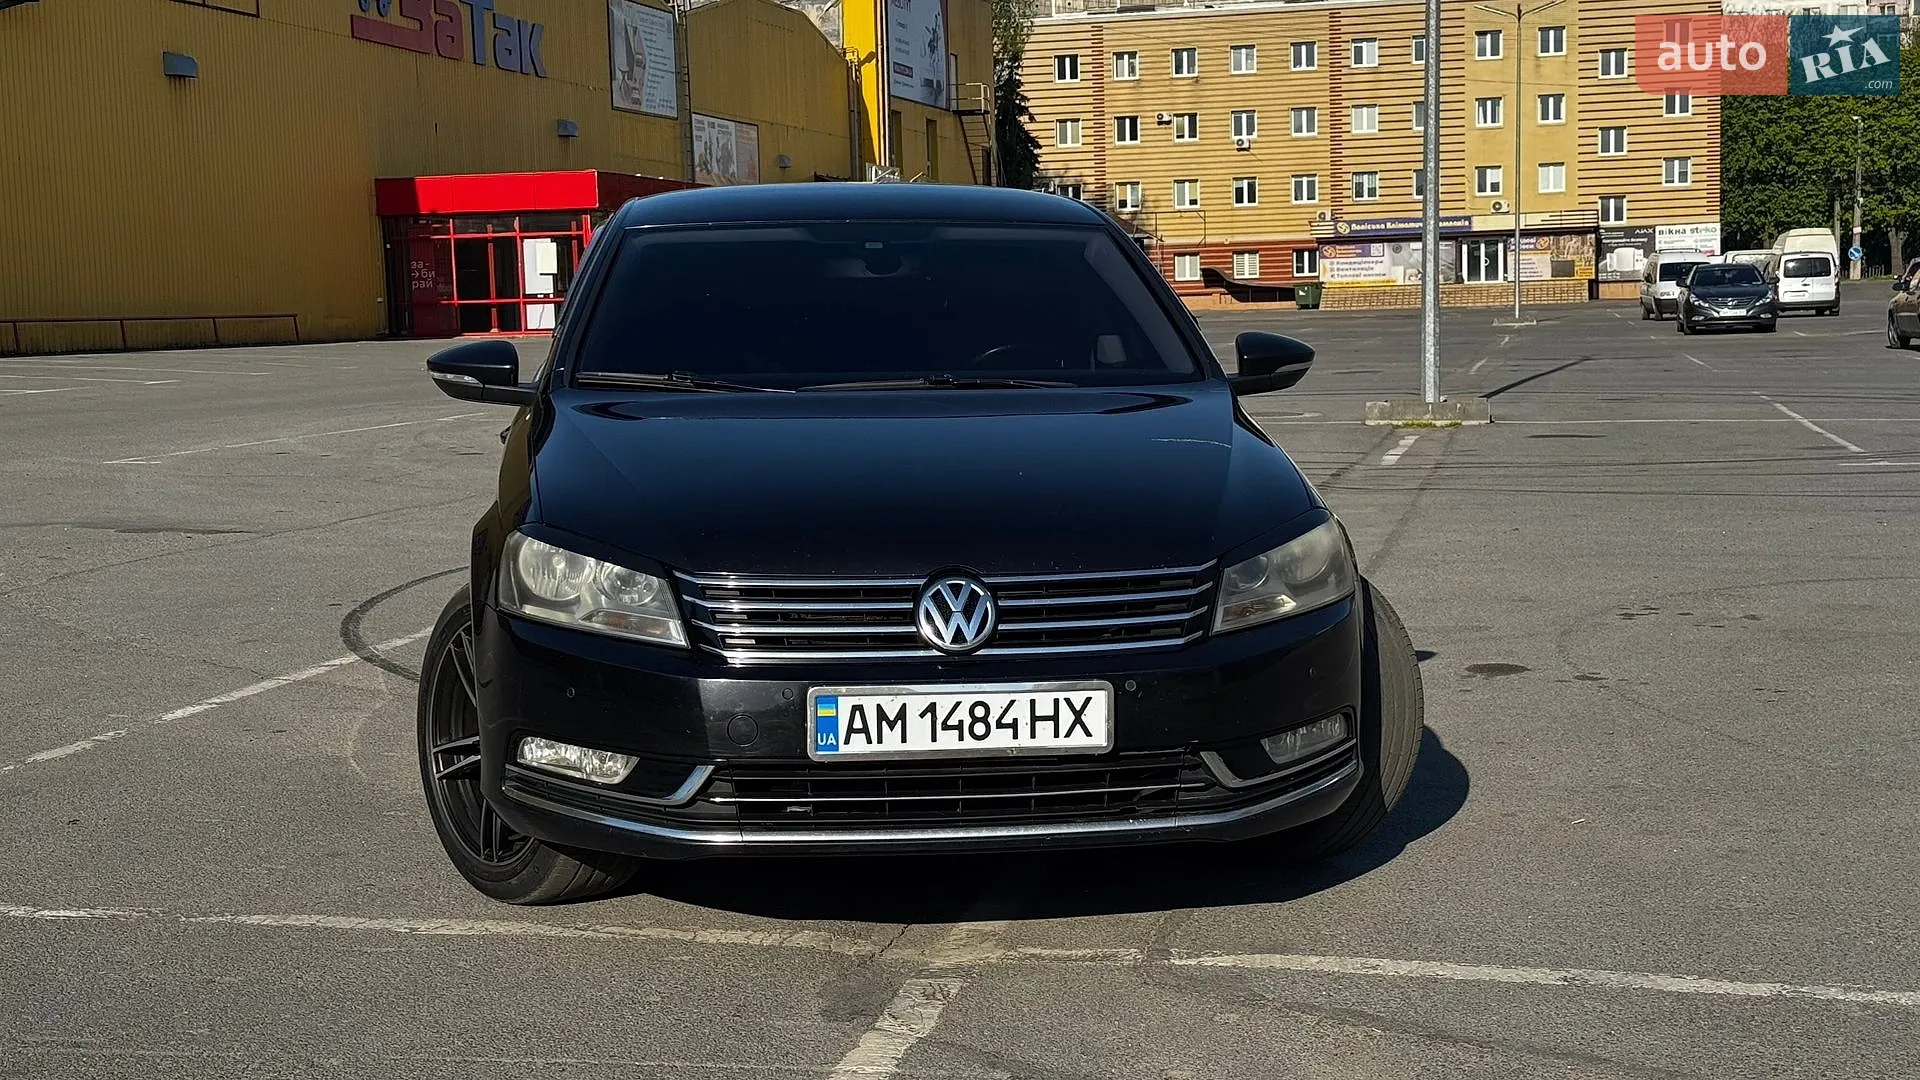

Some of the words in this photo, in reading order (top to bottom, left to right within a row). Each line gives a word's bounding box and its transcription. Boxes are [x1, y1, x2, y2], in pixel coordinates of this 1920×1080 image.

[412, 278, 433, 291] рай
[920, 579, 995, 650] VW
[843, 702, 908, 746] AM
[918, 699, 1019, 743] 1484
[1029, 696, 1094, 740] HX
[817, 732, 837, 746] UA
